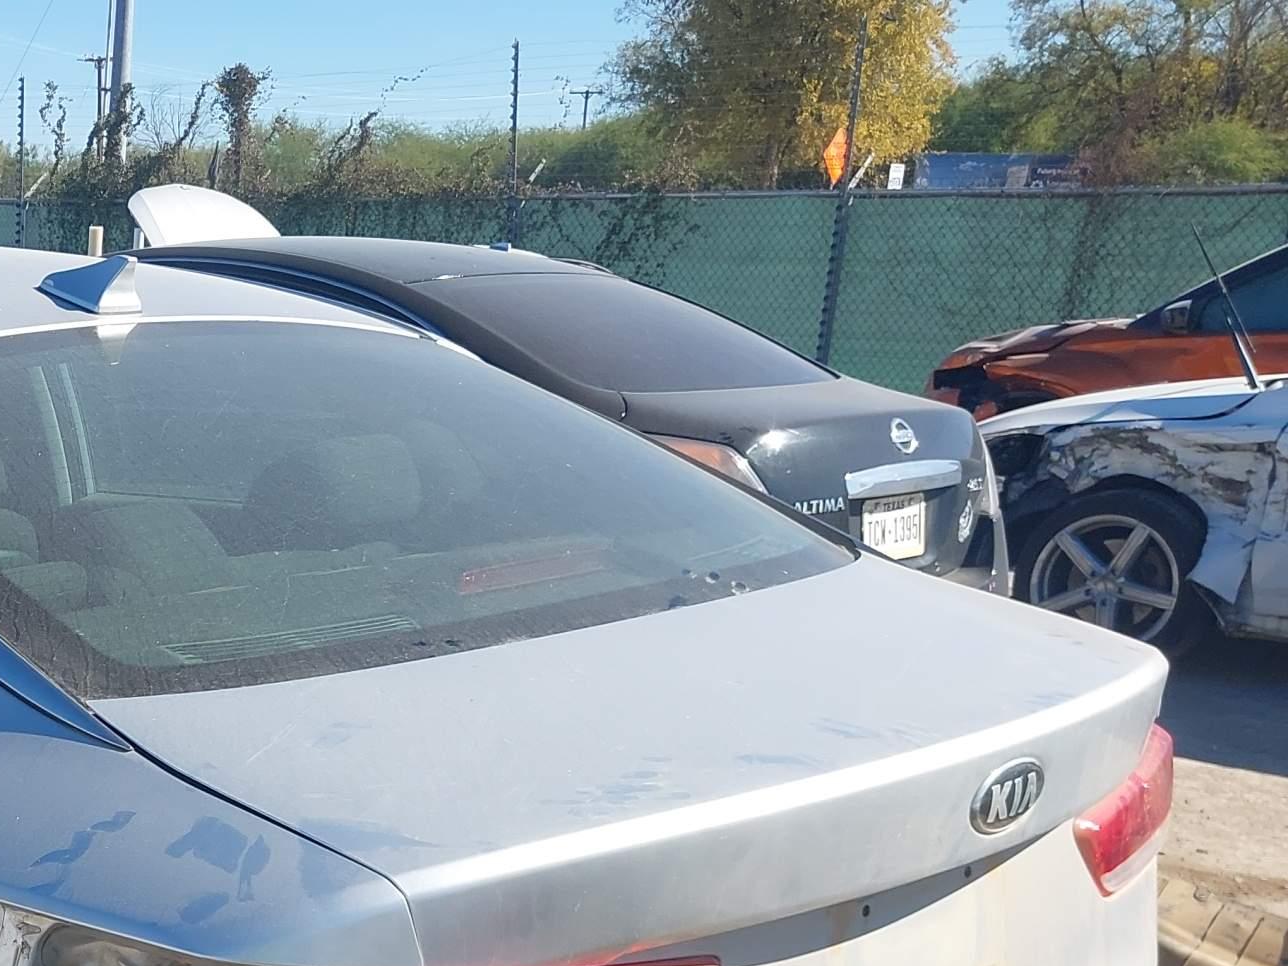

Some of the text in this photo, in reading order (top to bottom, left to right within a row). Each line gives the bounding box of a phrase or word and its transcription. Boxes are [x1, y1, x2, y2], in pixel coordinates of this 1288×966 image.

[793, 497, 846, 515] ALTIMA
[883, 500, 905, 512] TEXAS
[986, 771, 1037, 824] KIA
